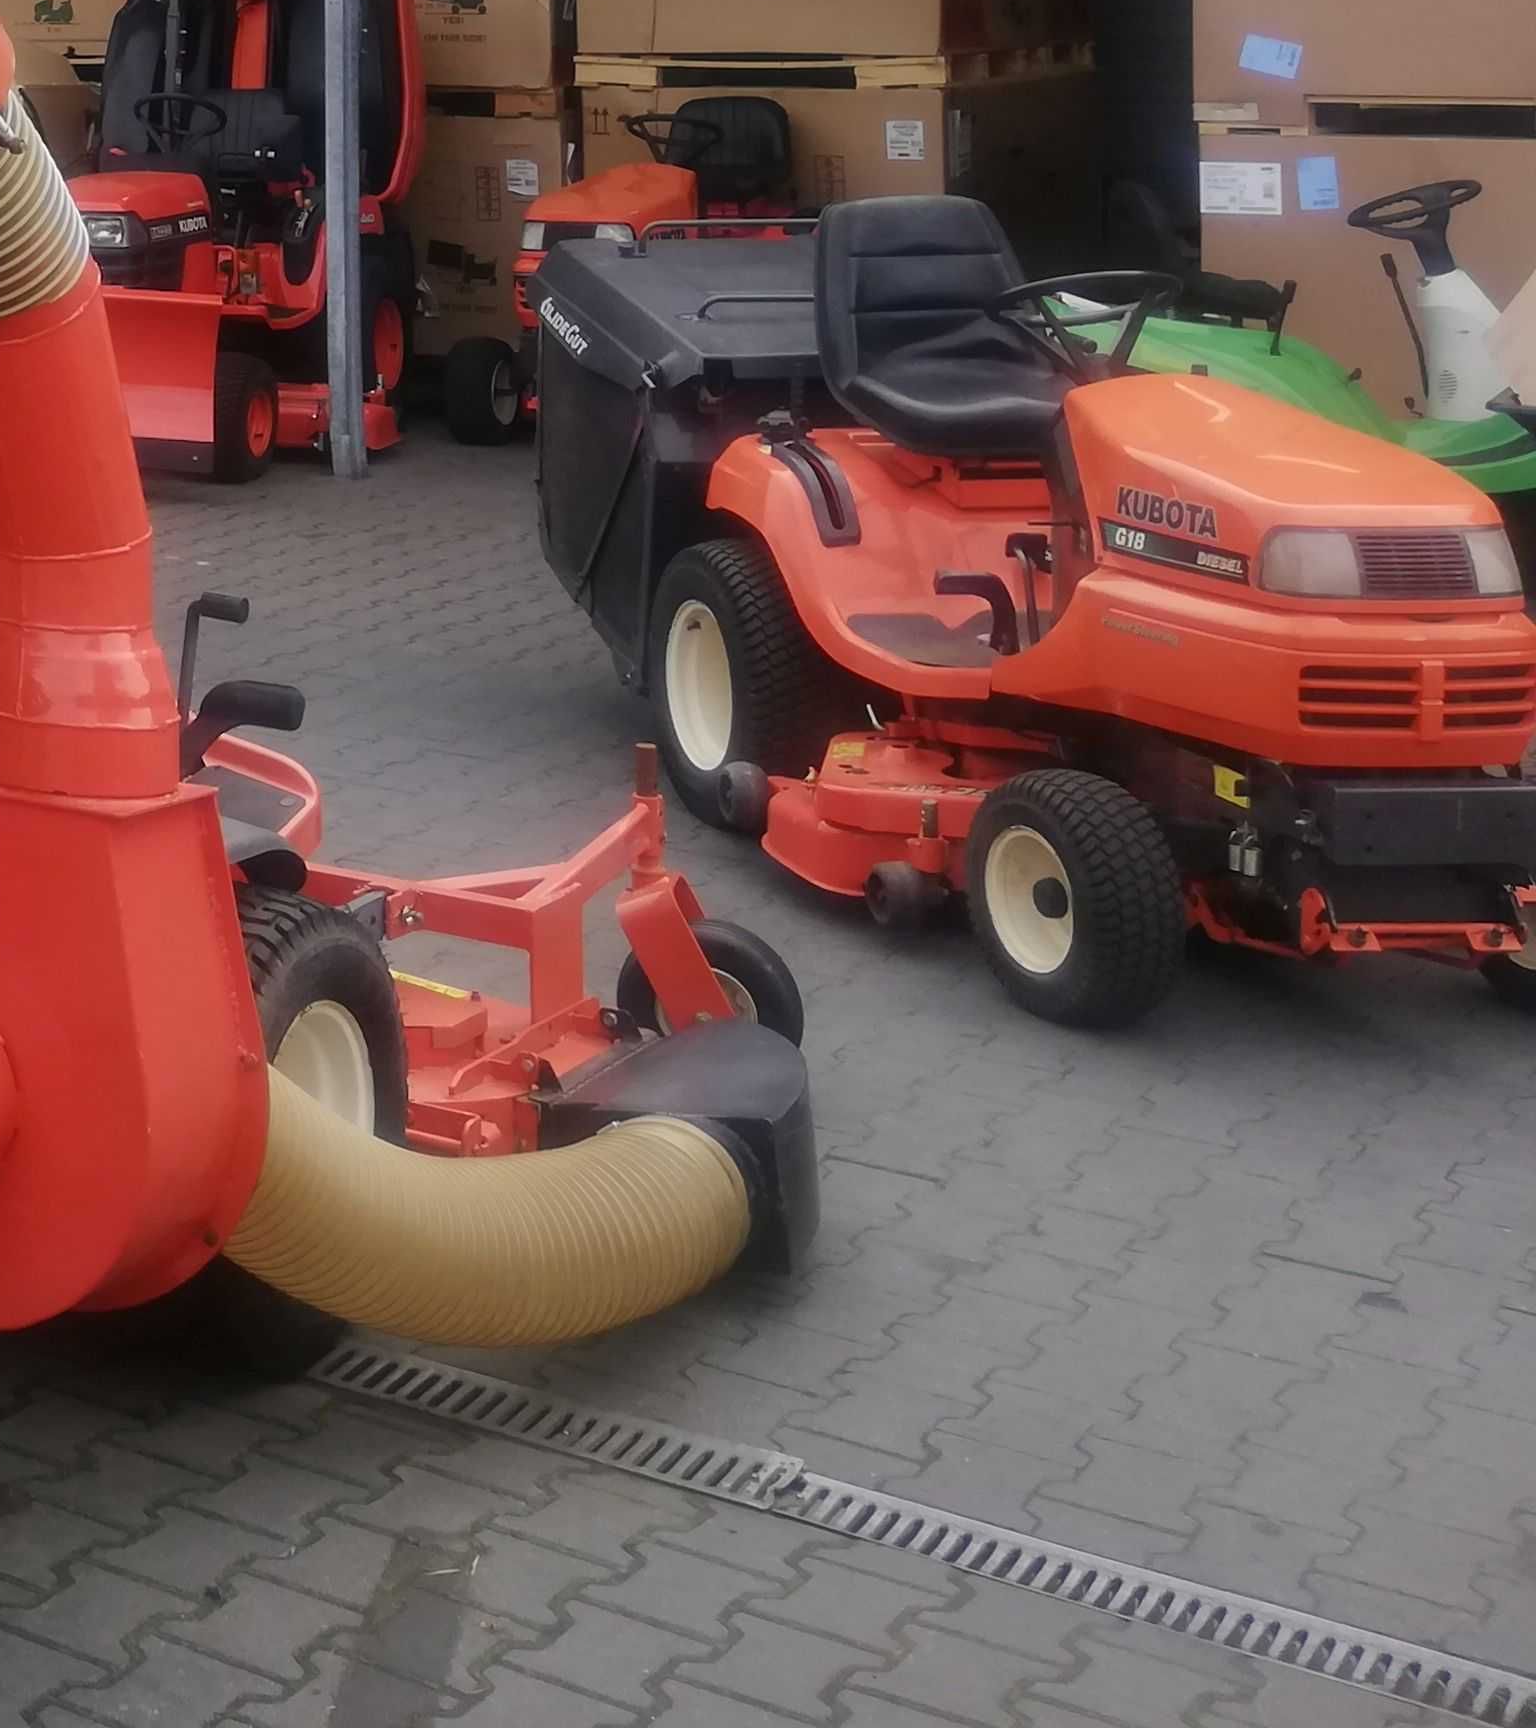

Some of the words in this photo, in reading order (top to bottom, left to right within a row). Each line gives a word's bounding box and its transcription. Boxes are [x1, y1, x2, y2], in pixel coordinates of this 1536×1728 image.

[1116, 485, 1218, 539] KUBOTA
[1115, 526, 1146, 550] G18
[1196, 551, 1244, 574] DIESEL
